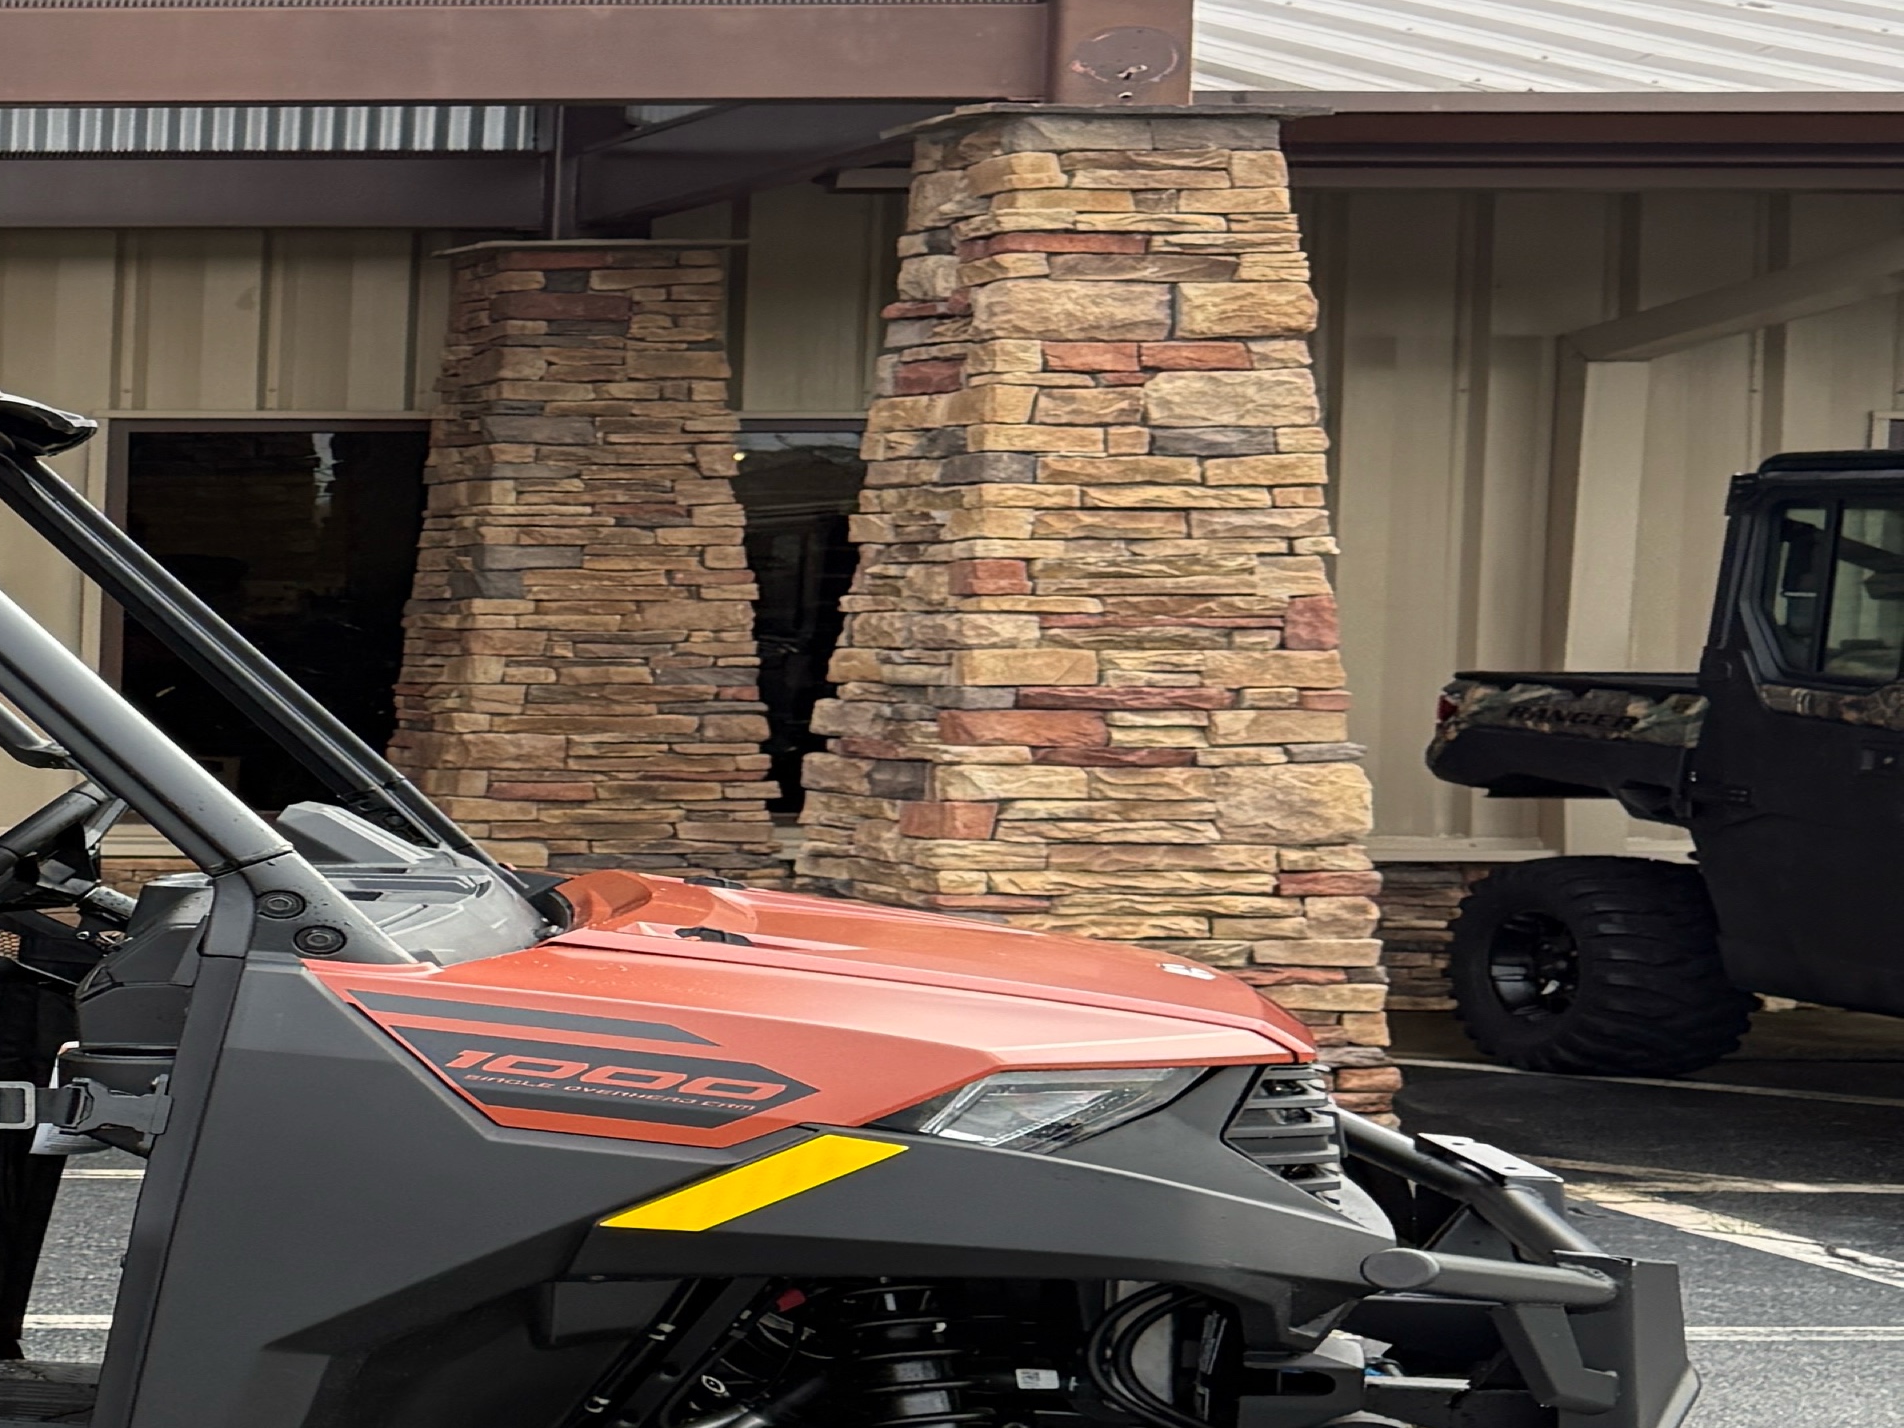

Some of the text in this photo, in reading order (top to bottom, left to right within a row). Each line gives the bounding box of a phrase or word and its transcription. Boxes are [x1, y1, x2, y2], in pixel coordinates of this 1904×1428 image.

[445, 1049, 788, 1101] 1000
[463, 1074, 556, 1088] SINGLE
[700, 1100, 757, 1111] CAM
